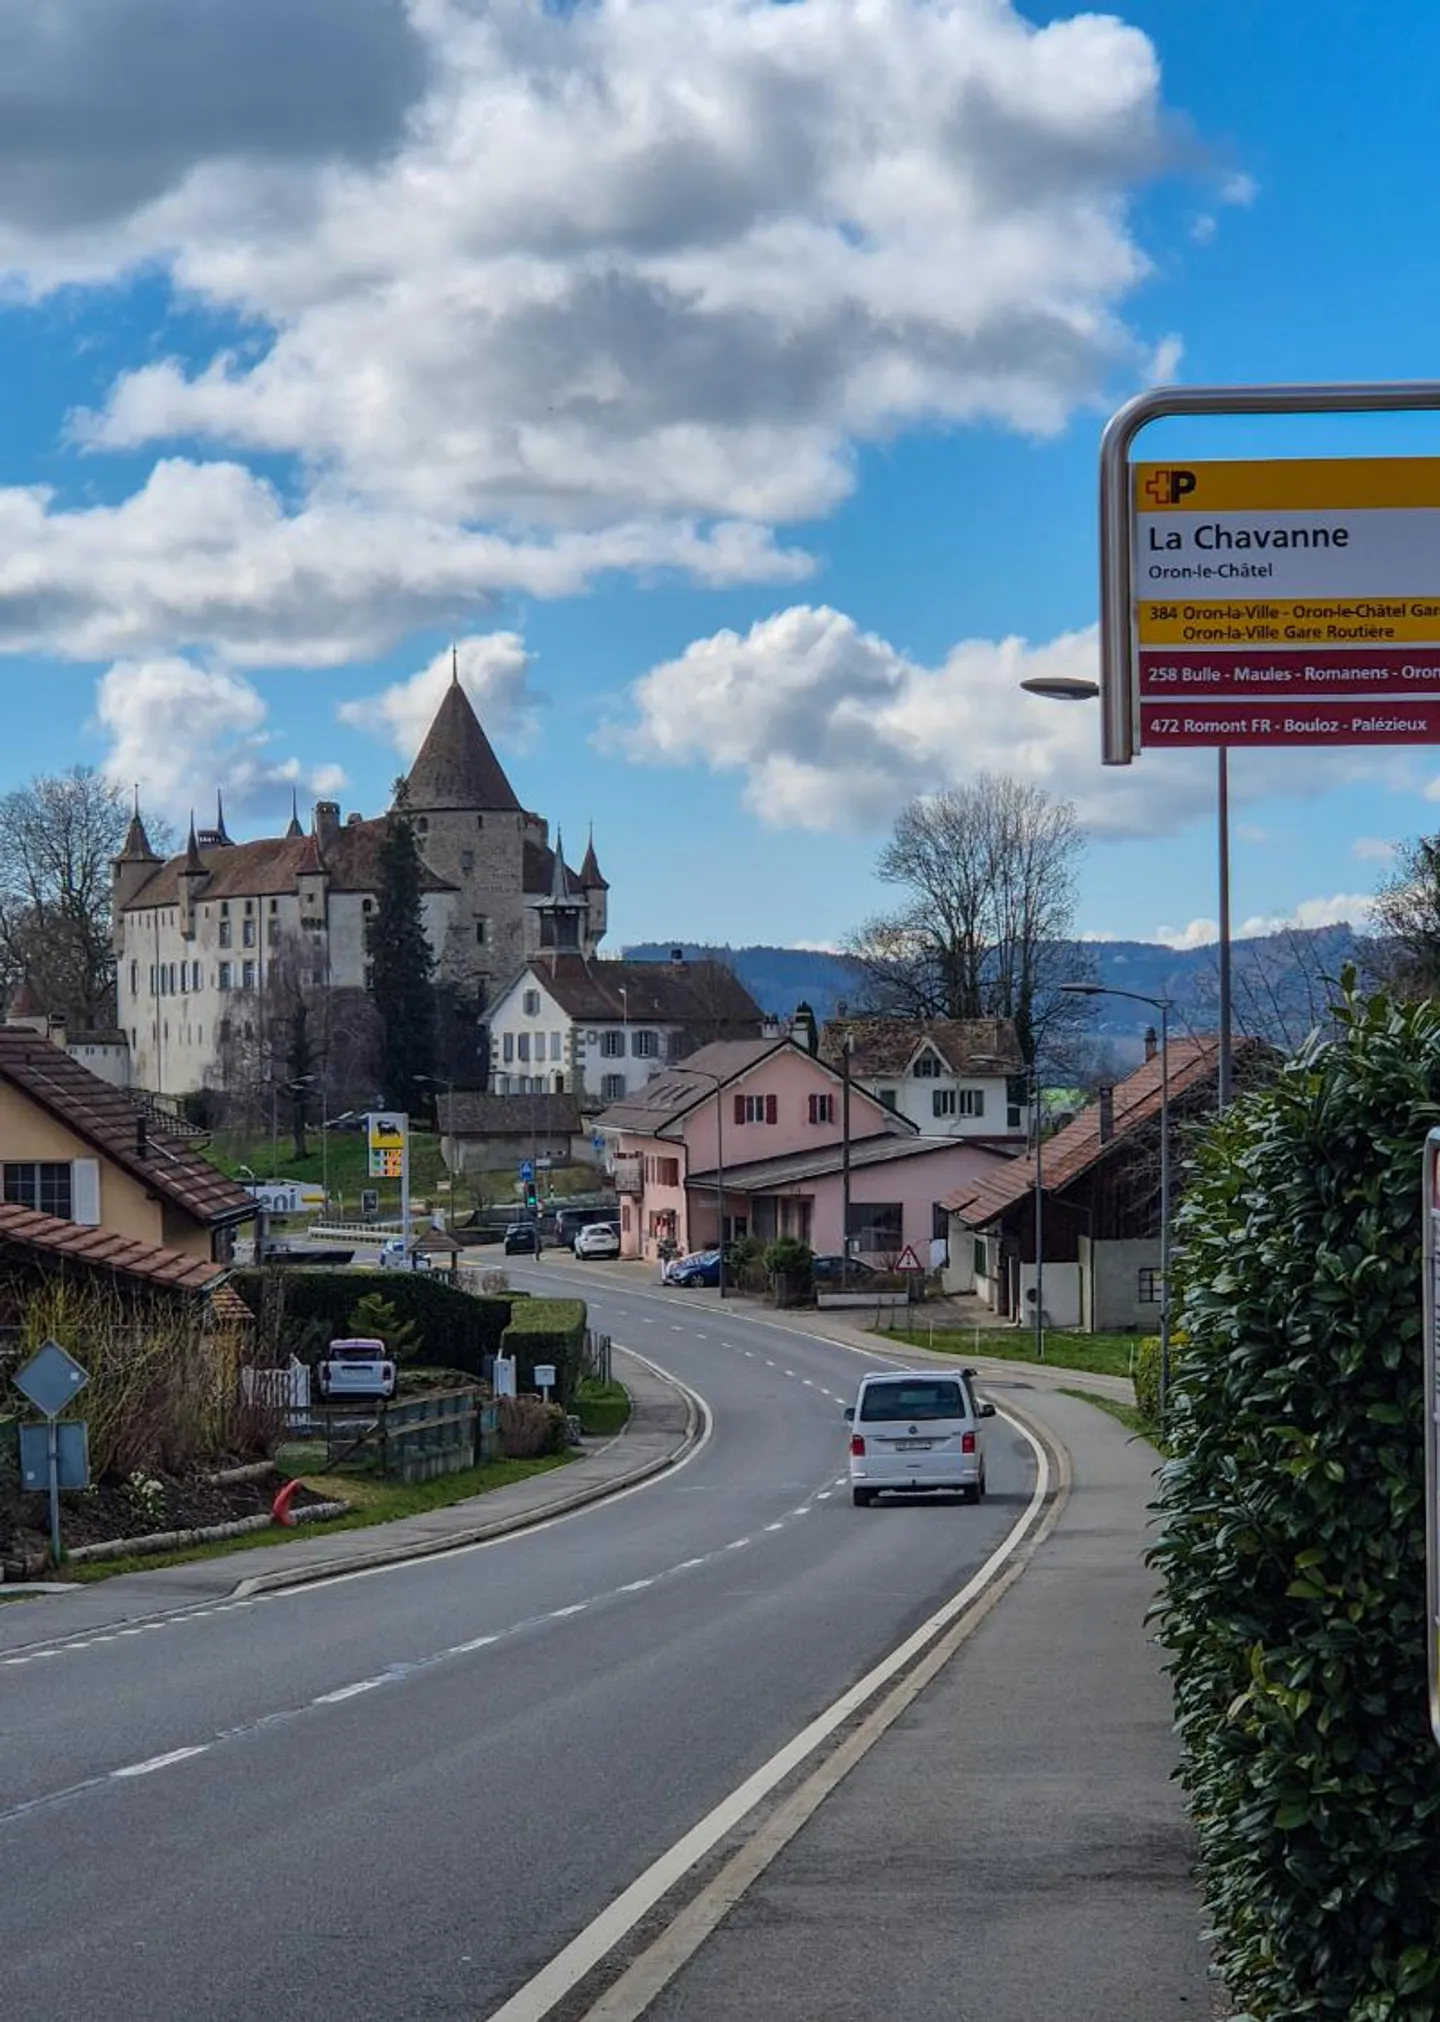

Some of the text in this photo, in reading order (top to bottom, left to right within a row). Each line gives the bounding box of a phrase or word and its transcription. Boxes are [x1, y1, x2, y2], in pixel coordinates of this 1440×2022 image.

[1150, 524, 1349, 550] La Chavanne
[1149, 562, 1273, 579] Oron-le-Châtel
[1150, 606, 1178, 620] 384
[1182, 604, 1280, 620] Oron-la-Ville
[1293, 602, 1406, 618] Oron-le-Châtel
[1182, 625, 1280, 640] Oron-la-Ville
[1284, 625, 1322, 639] Gare
[1149, 667, 1178, 681] 258
[1181, 667, 1221, 681] Bulle
[1233, 666, 1292, 681] Maules
[1304, 666, 1389, 680] Romanens
[1150, 719, 1180, 733] 472
[1184, 719, 1248, 733] Romont
[1251, 718, 1271, 732] FR
[1284, 717, 1339, 732] Bouloz
[1352, 716, 1428, 731] Palézieux
